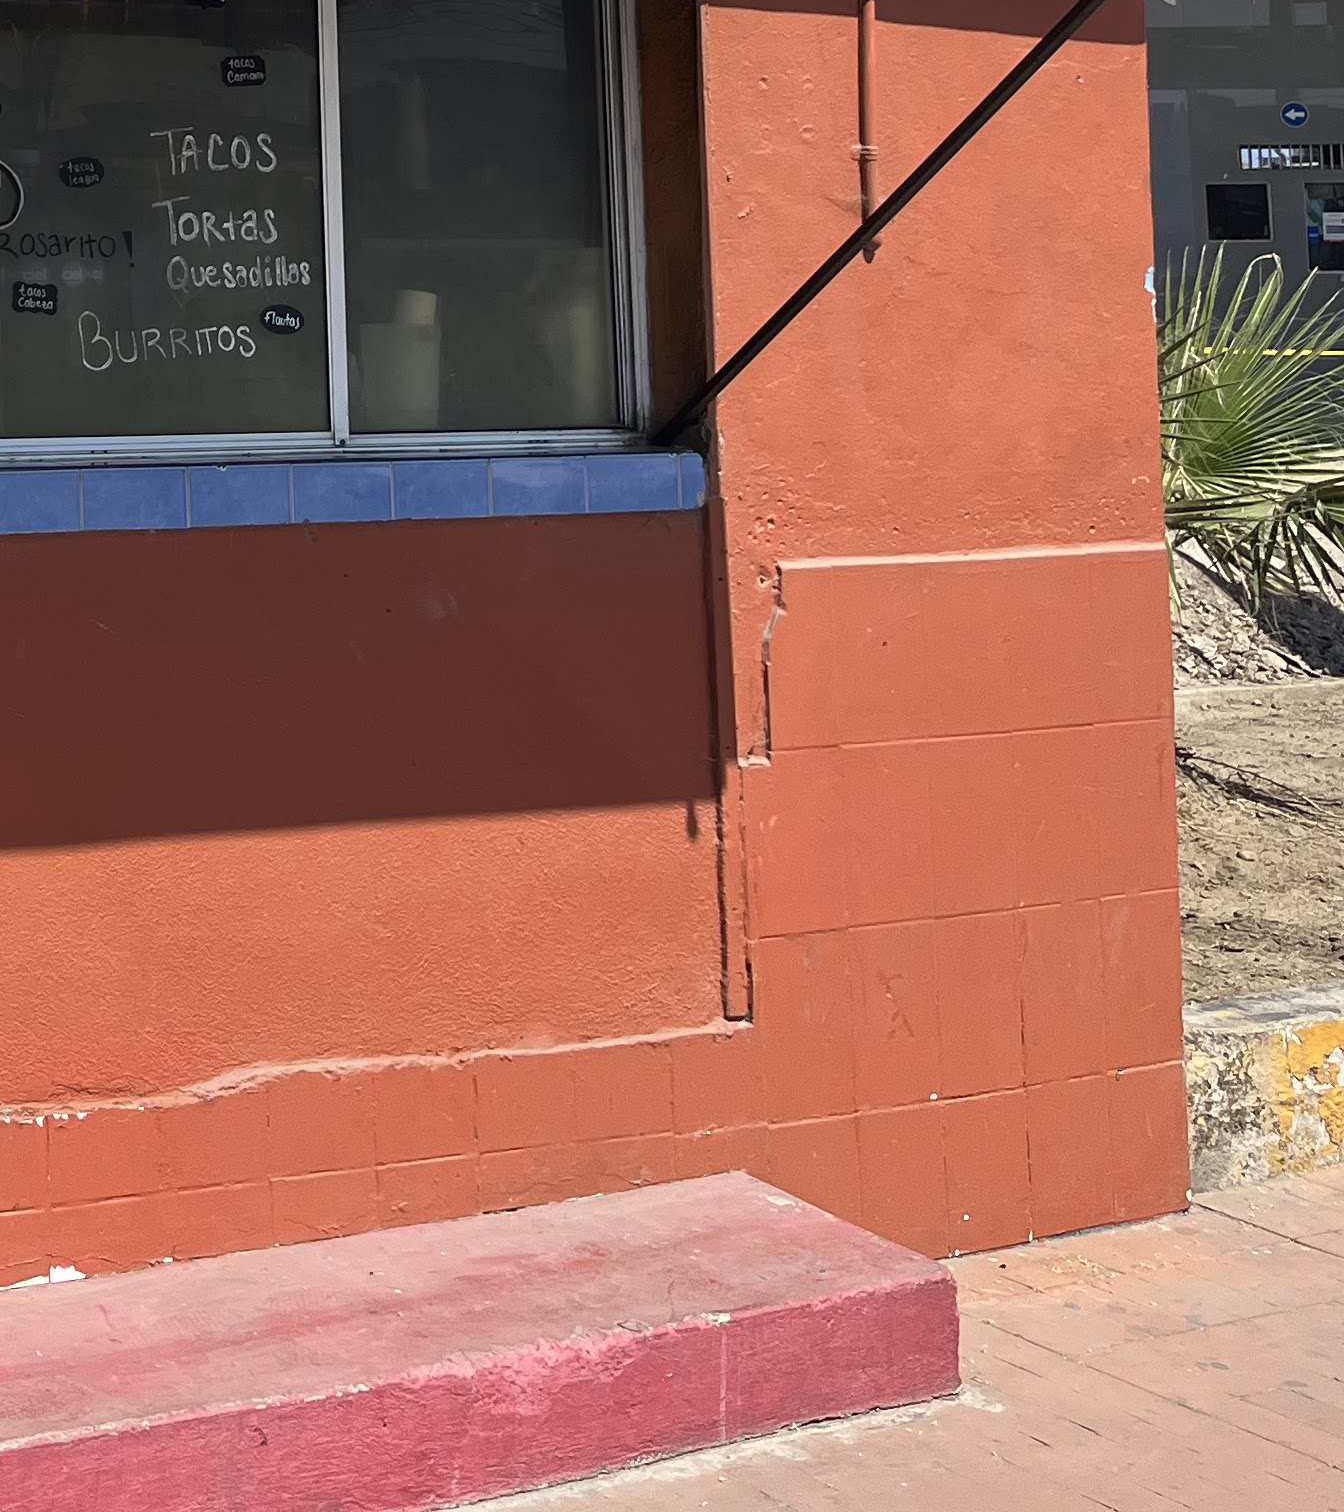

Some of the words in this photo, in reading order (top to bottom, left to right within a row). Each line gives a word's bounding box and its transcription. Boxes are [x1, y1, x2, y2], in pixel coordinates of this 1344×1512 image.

[149, 126, 278, 176] TACOS
[166, 255, 311, 294] Quesadillas
[77, 310, 257, 371] BURRITOS
